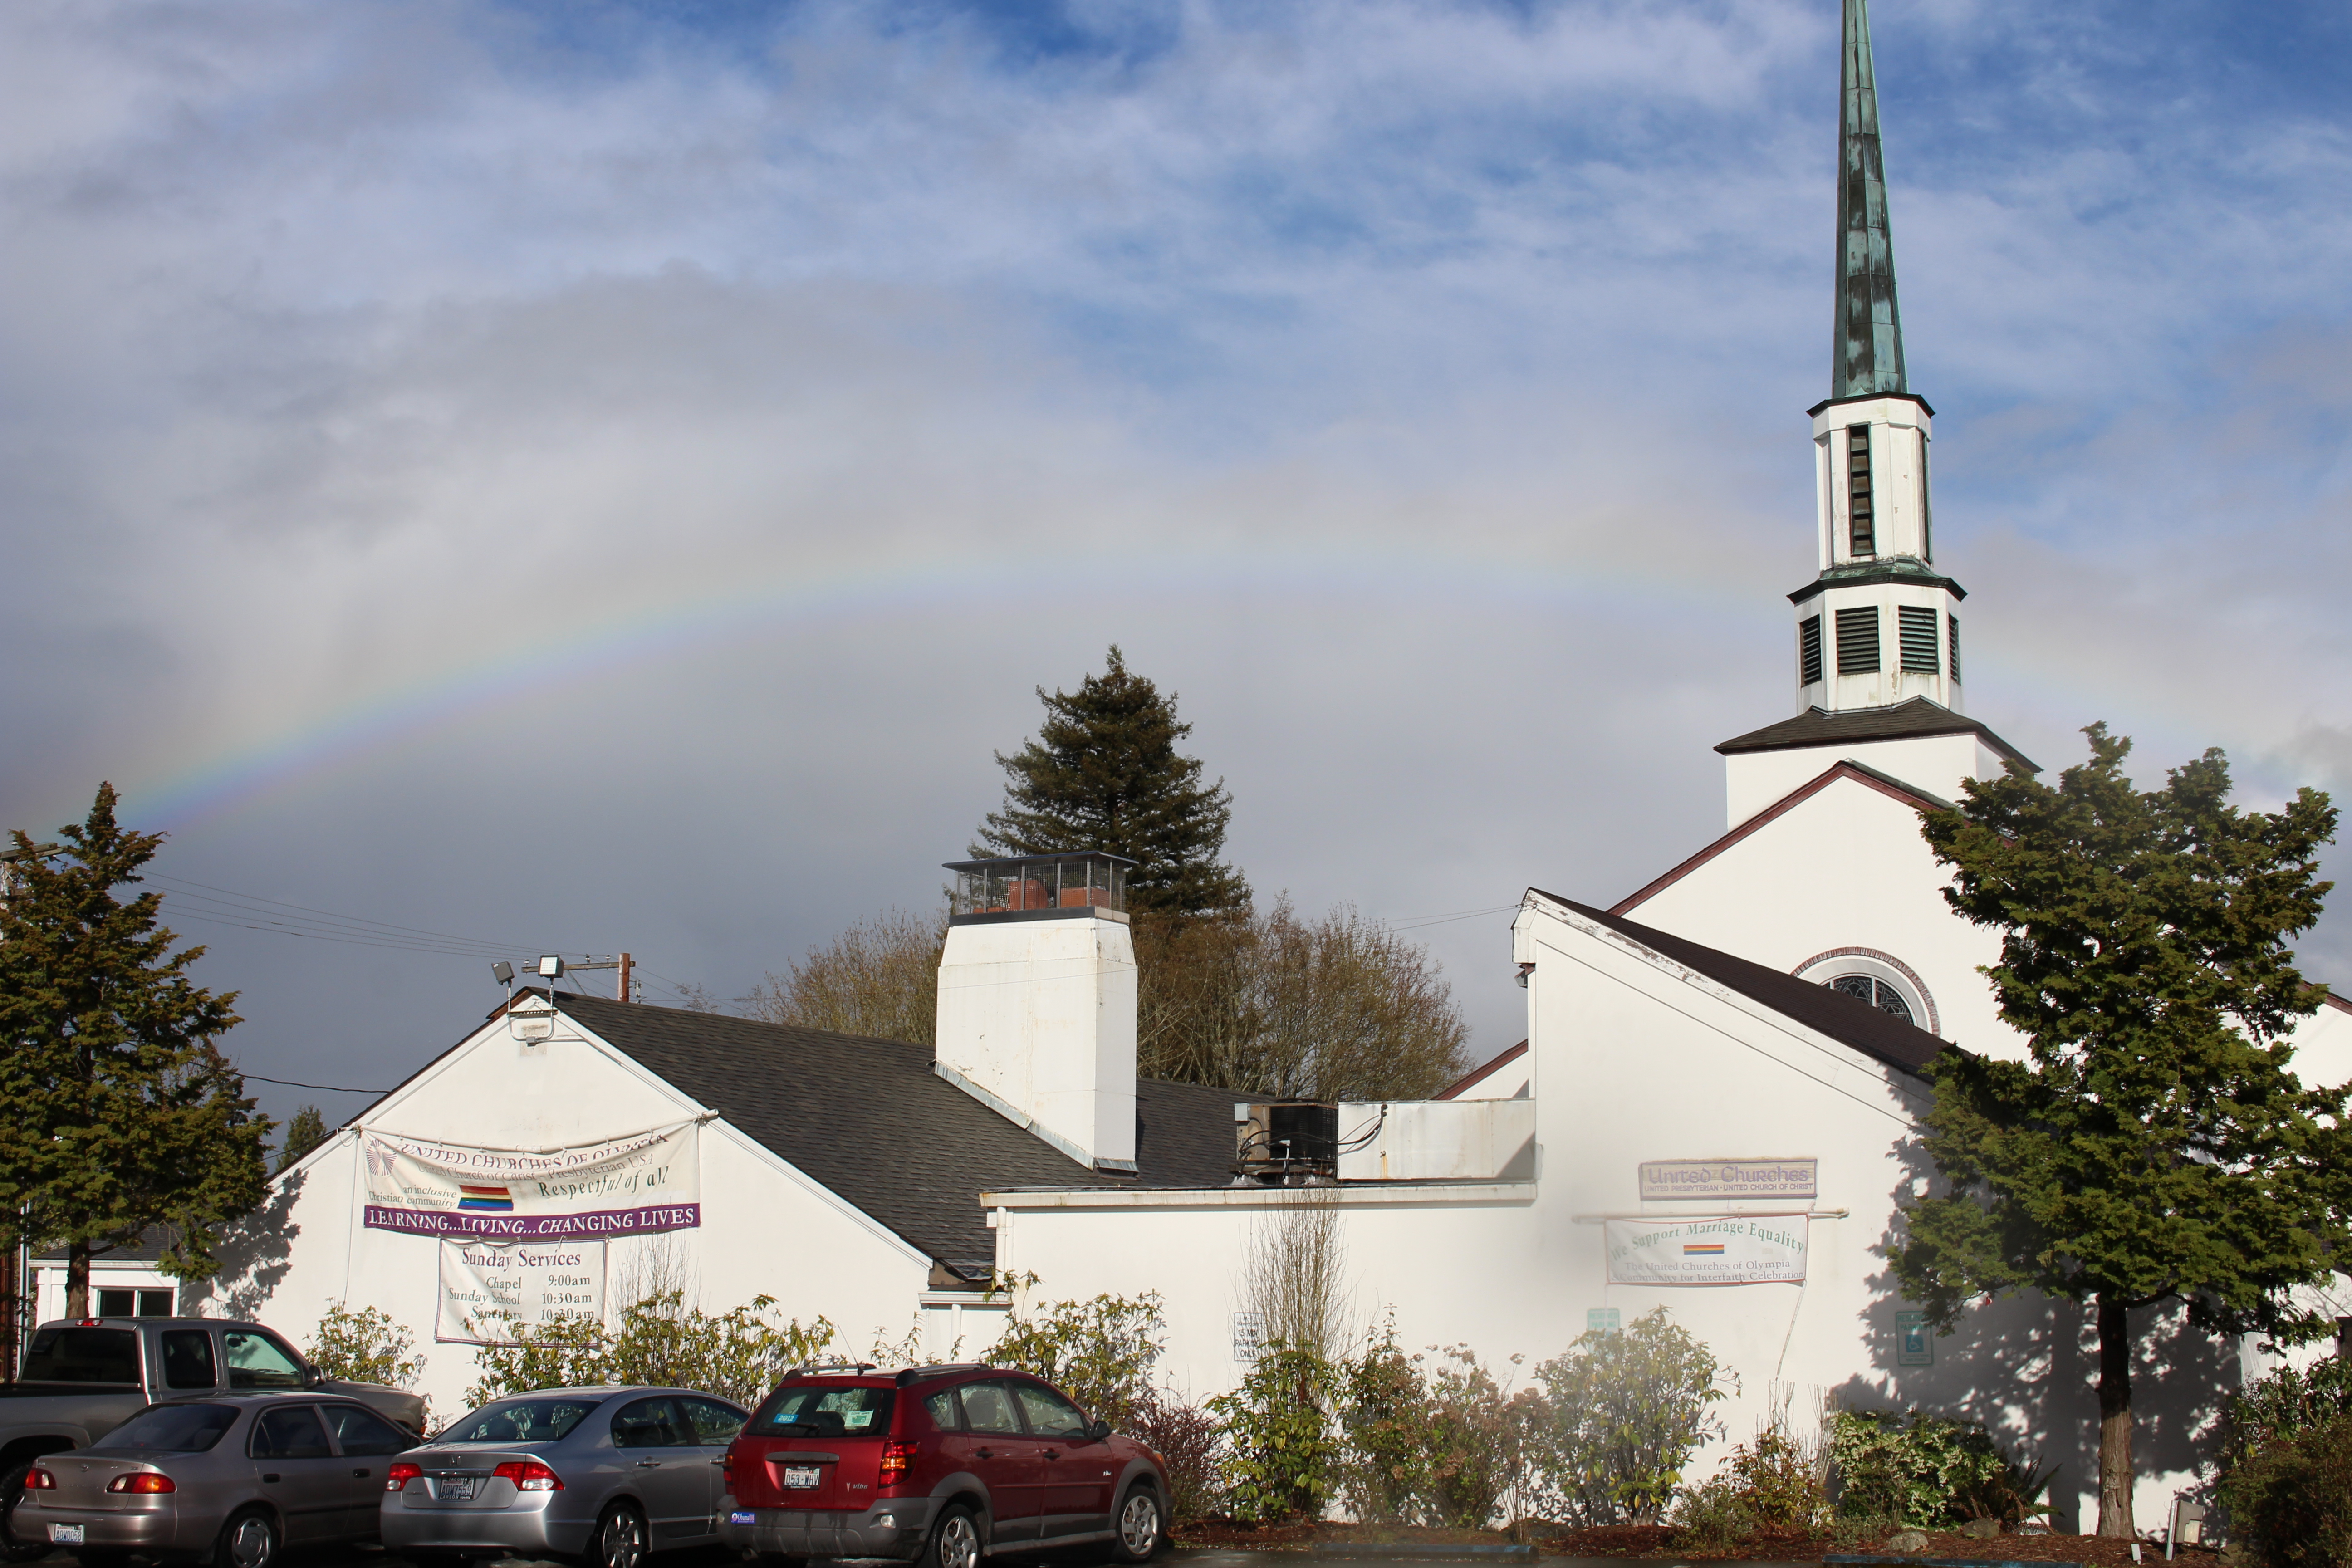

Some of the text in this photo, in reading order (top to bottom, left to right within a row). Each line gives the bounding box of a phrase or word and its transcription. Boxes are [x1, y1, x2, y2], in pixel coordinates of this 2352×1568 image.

[401, 1143, 467, 1165] UNITED
[472, 1154, 562, 1170] CHURCHES
[567, 1153, 587, 1166] OF
[447, 1166, 484, 1180] Church
[548, 1161, 627, 1179] Presbyterian
[627, 1152, 654, 1168] USA
[1648, 1166, 1809, 1184] United Churches
[415, 1184, 457, 1198] inclusive
[538, 1165, 670, 1200] Respectful of all
[369, 1191, 456, 1210] Christian community
[640, 1207, 694, 1227] LIVES
[1632, 1228, 1680, 1250] Support
[1686, 1220, 1744, 1236] Marriage
[1749, 1222, 1804, 1254] Equality
[462, 1247, 581, 1272] Sunday Services
[1625, 1259, 1790, 1271] The United Churches of Olympia
[486, 1274, 590, 1292] Chapel 9:00am
[1619, 1273, 1677, 1283] Community
[1681, 1273, 1694, 1282] for
[1698, 1272, 1746, 1282] Interfaith
[1750, 1270, 1803, 1280] Celebration
[449, 1287, 592, 1305] Sunday School 10:30am
[1239, 1328, 1245, 1337] 15
[1235, 1339, 1260, 1347] PARKING
